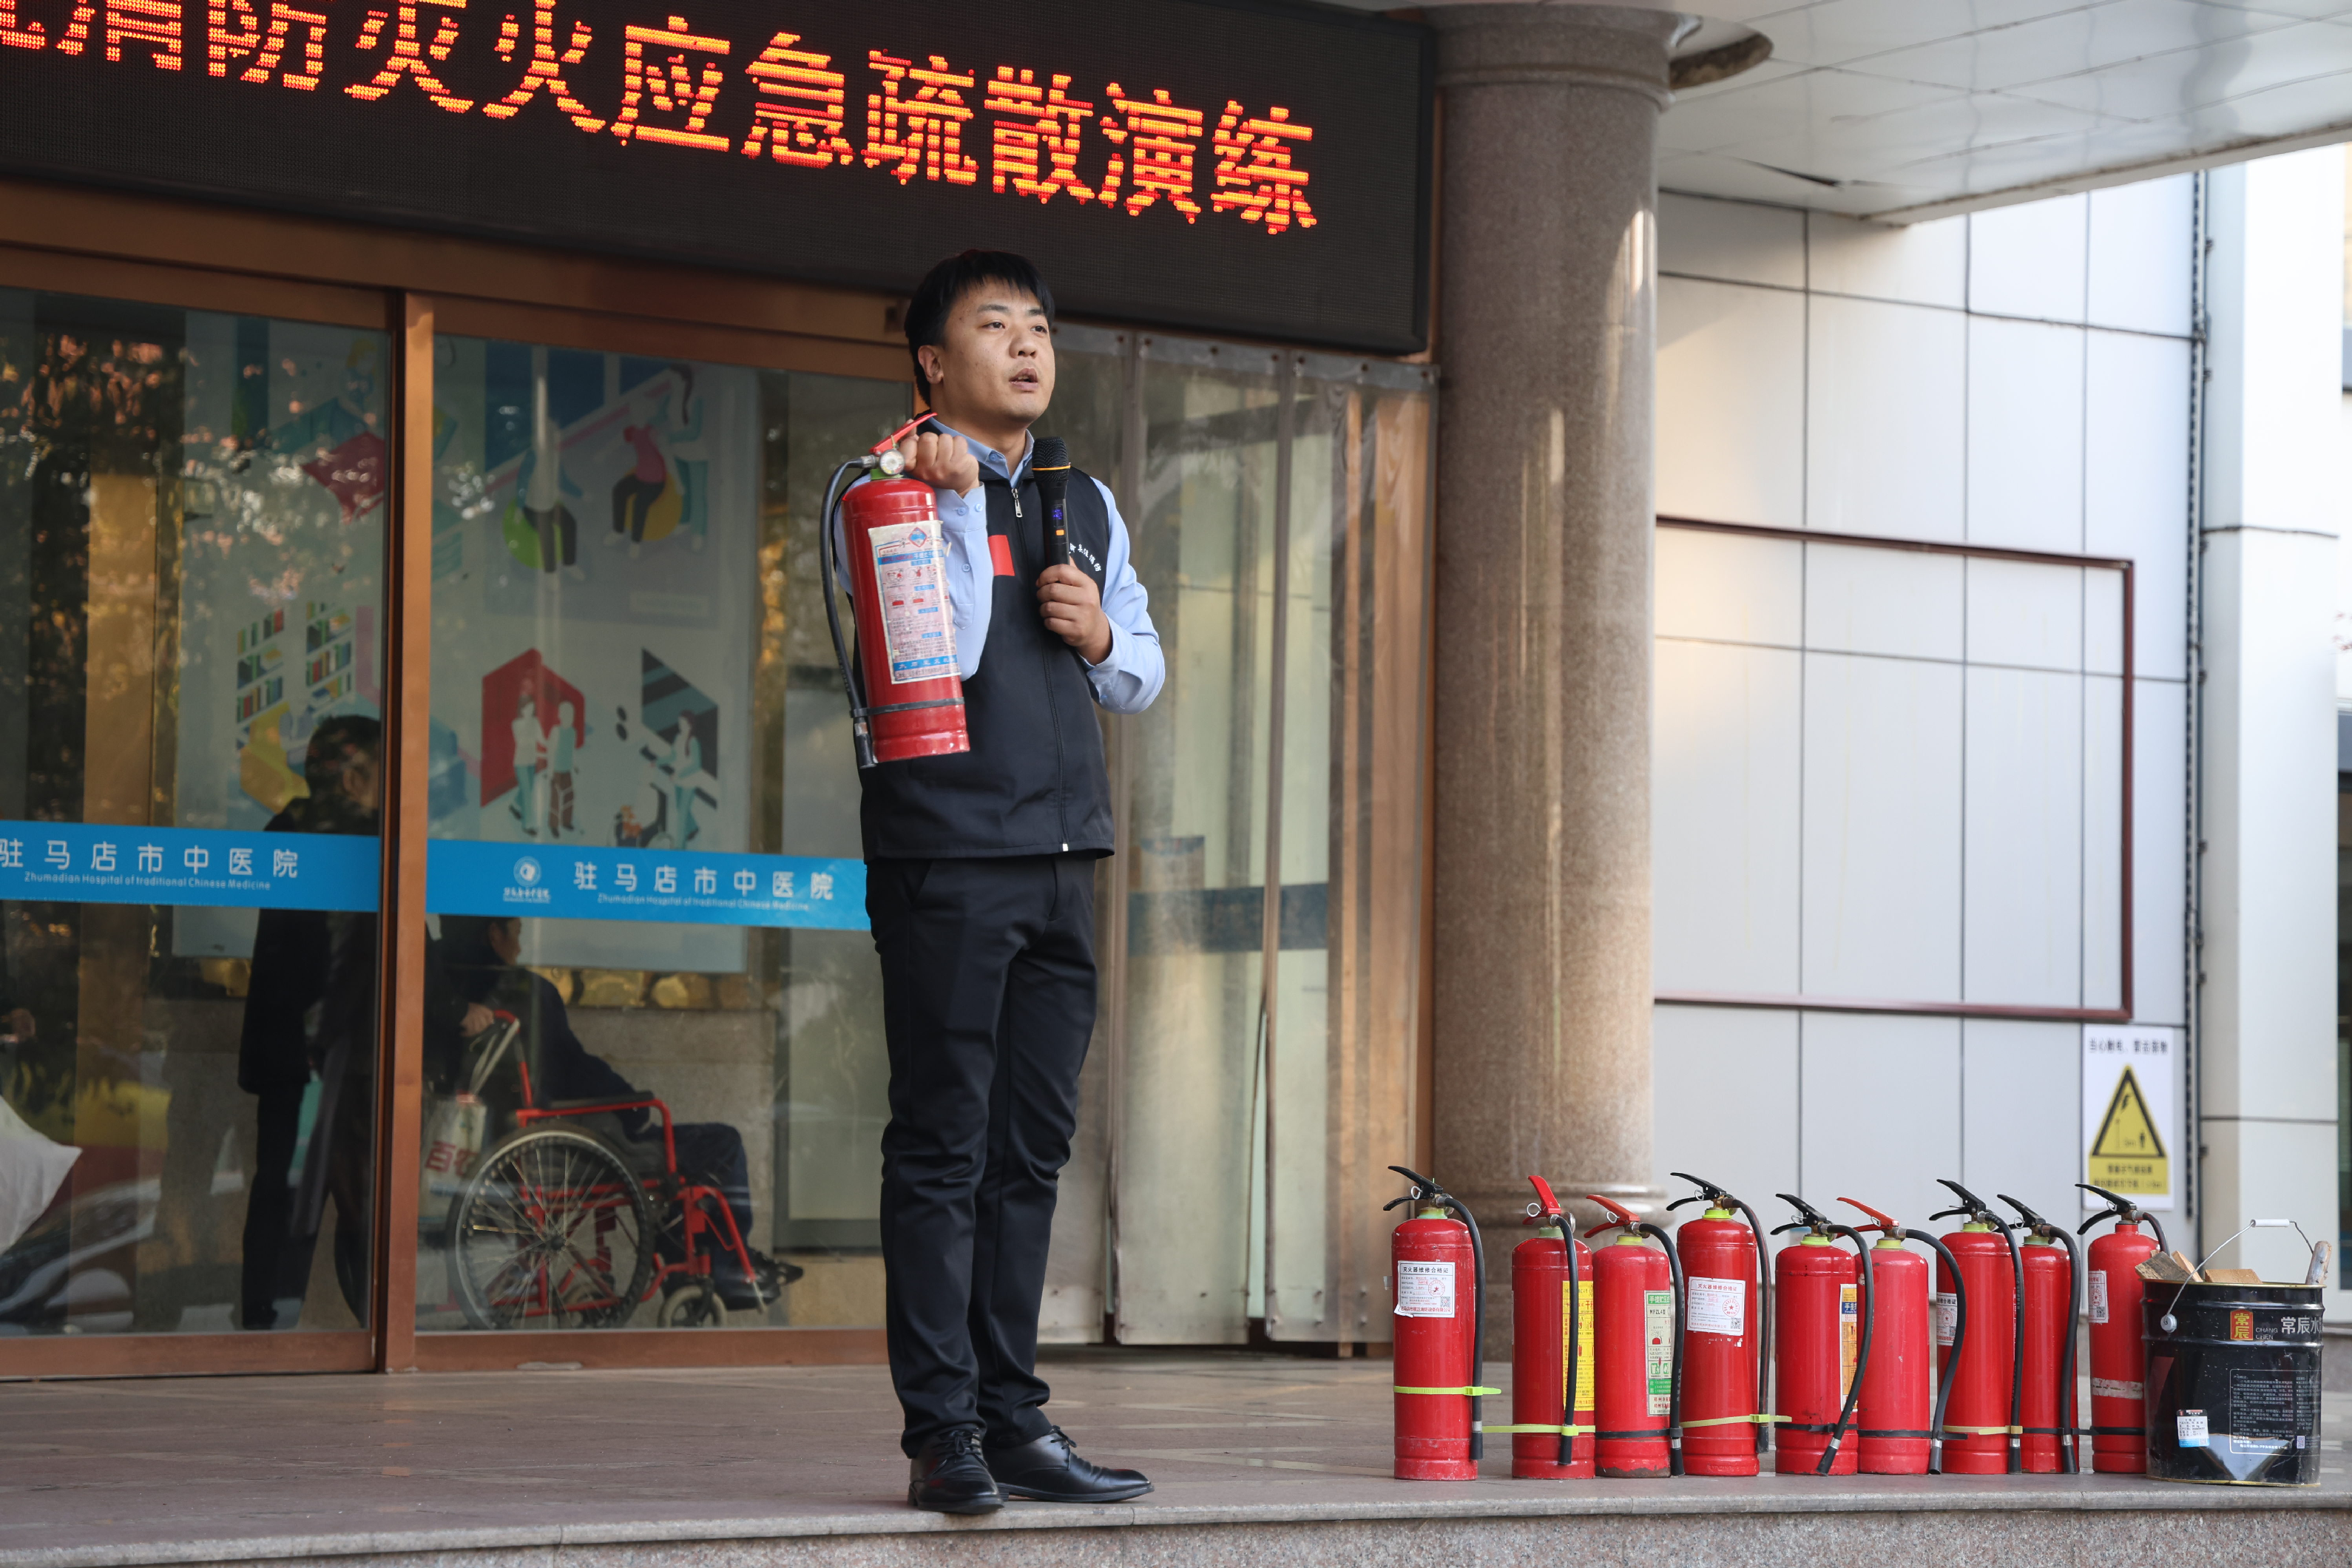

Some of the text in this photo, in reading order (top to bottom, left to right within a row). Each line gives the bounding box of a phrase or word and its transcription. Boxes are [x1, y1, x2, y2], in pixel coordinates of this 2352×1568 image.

[0, 839, 298, 879] 驻马店市中医院
[24, 871, 271, 891] Zhumadian Hospital of traditional Chinese Medicine
[572, 862, 834, 900] 驻马店市中医院
[2234, 1312, 2250, 1339] 常辰
